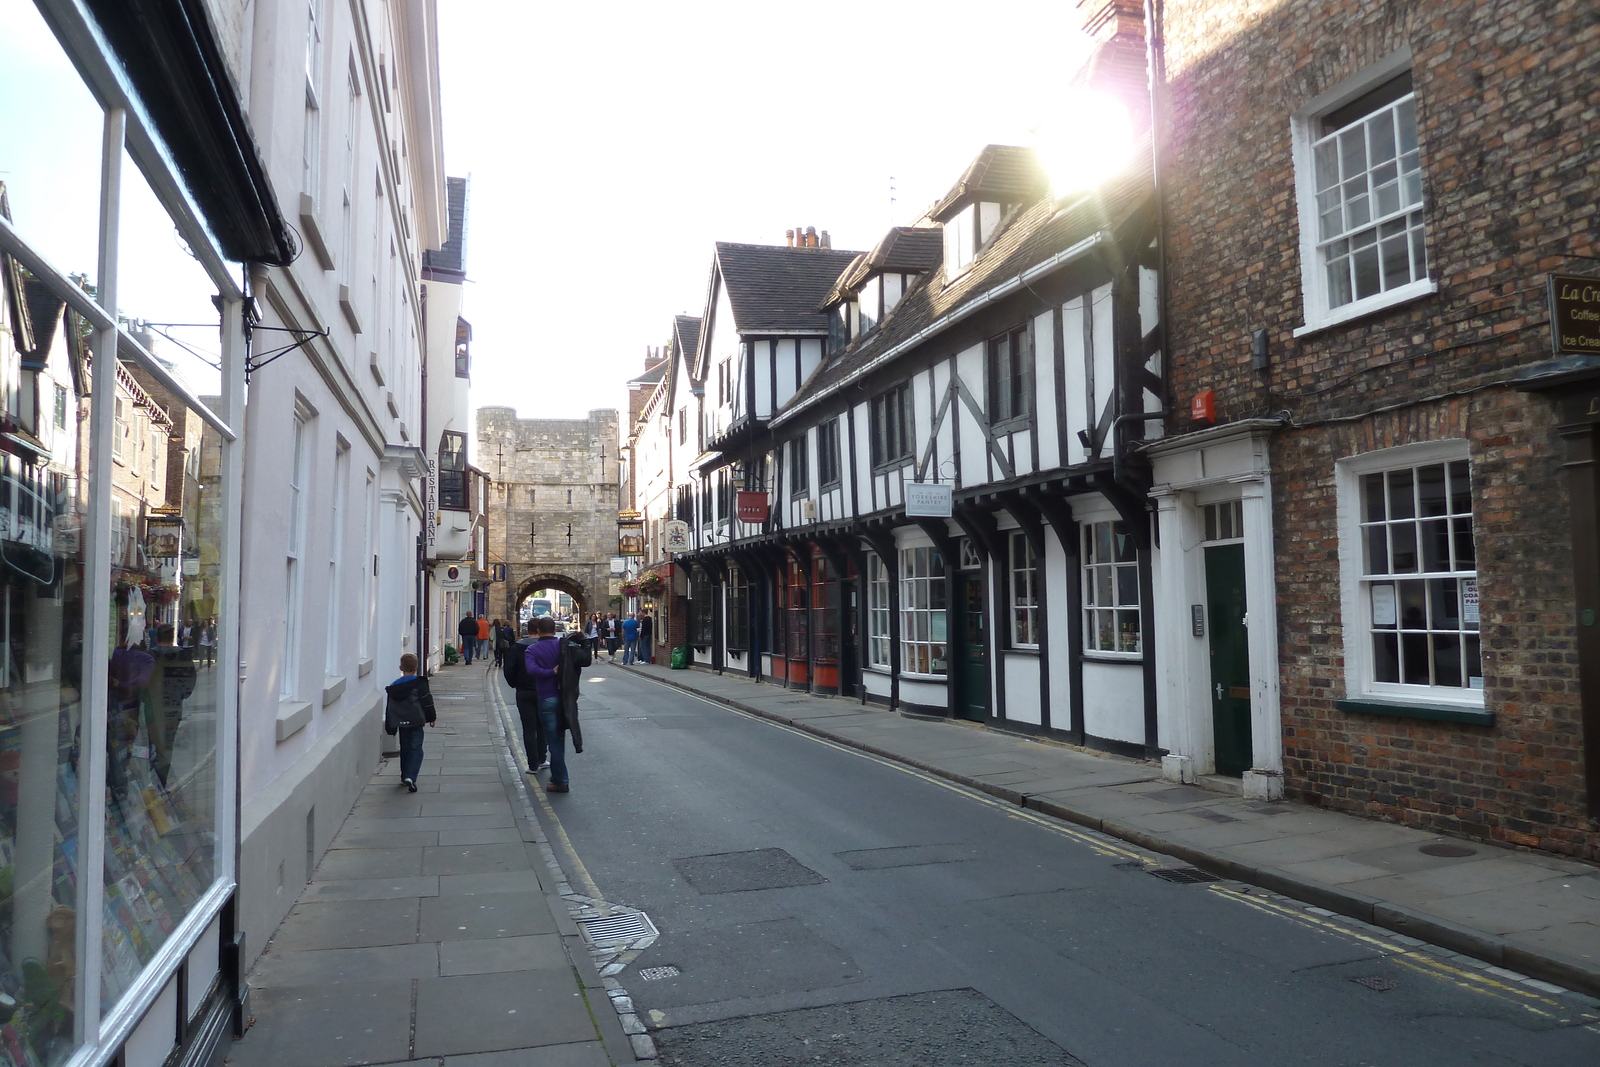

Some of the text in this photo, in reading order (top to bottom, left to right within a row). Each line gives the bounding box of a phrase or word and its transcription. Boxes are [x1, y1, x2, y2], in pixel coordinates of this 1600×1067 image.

[1560, 284, 1579, 300] La
[1570, 309, 1599, 321] Coffee
[1562, 334, 1576, 346] Ice
[428, 459, 436, 547] RESTAURANT
